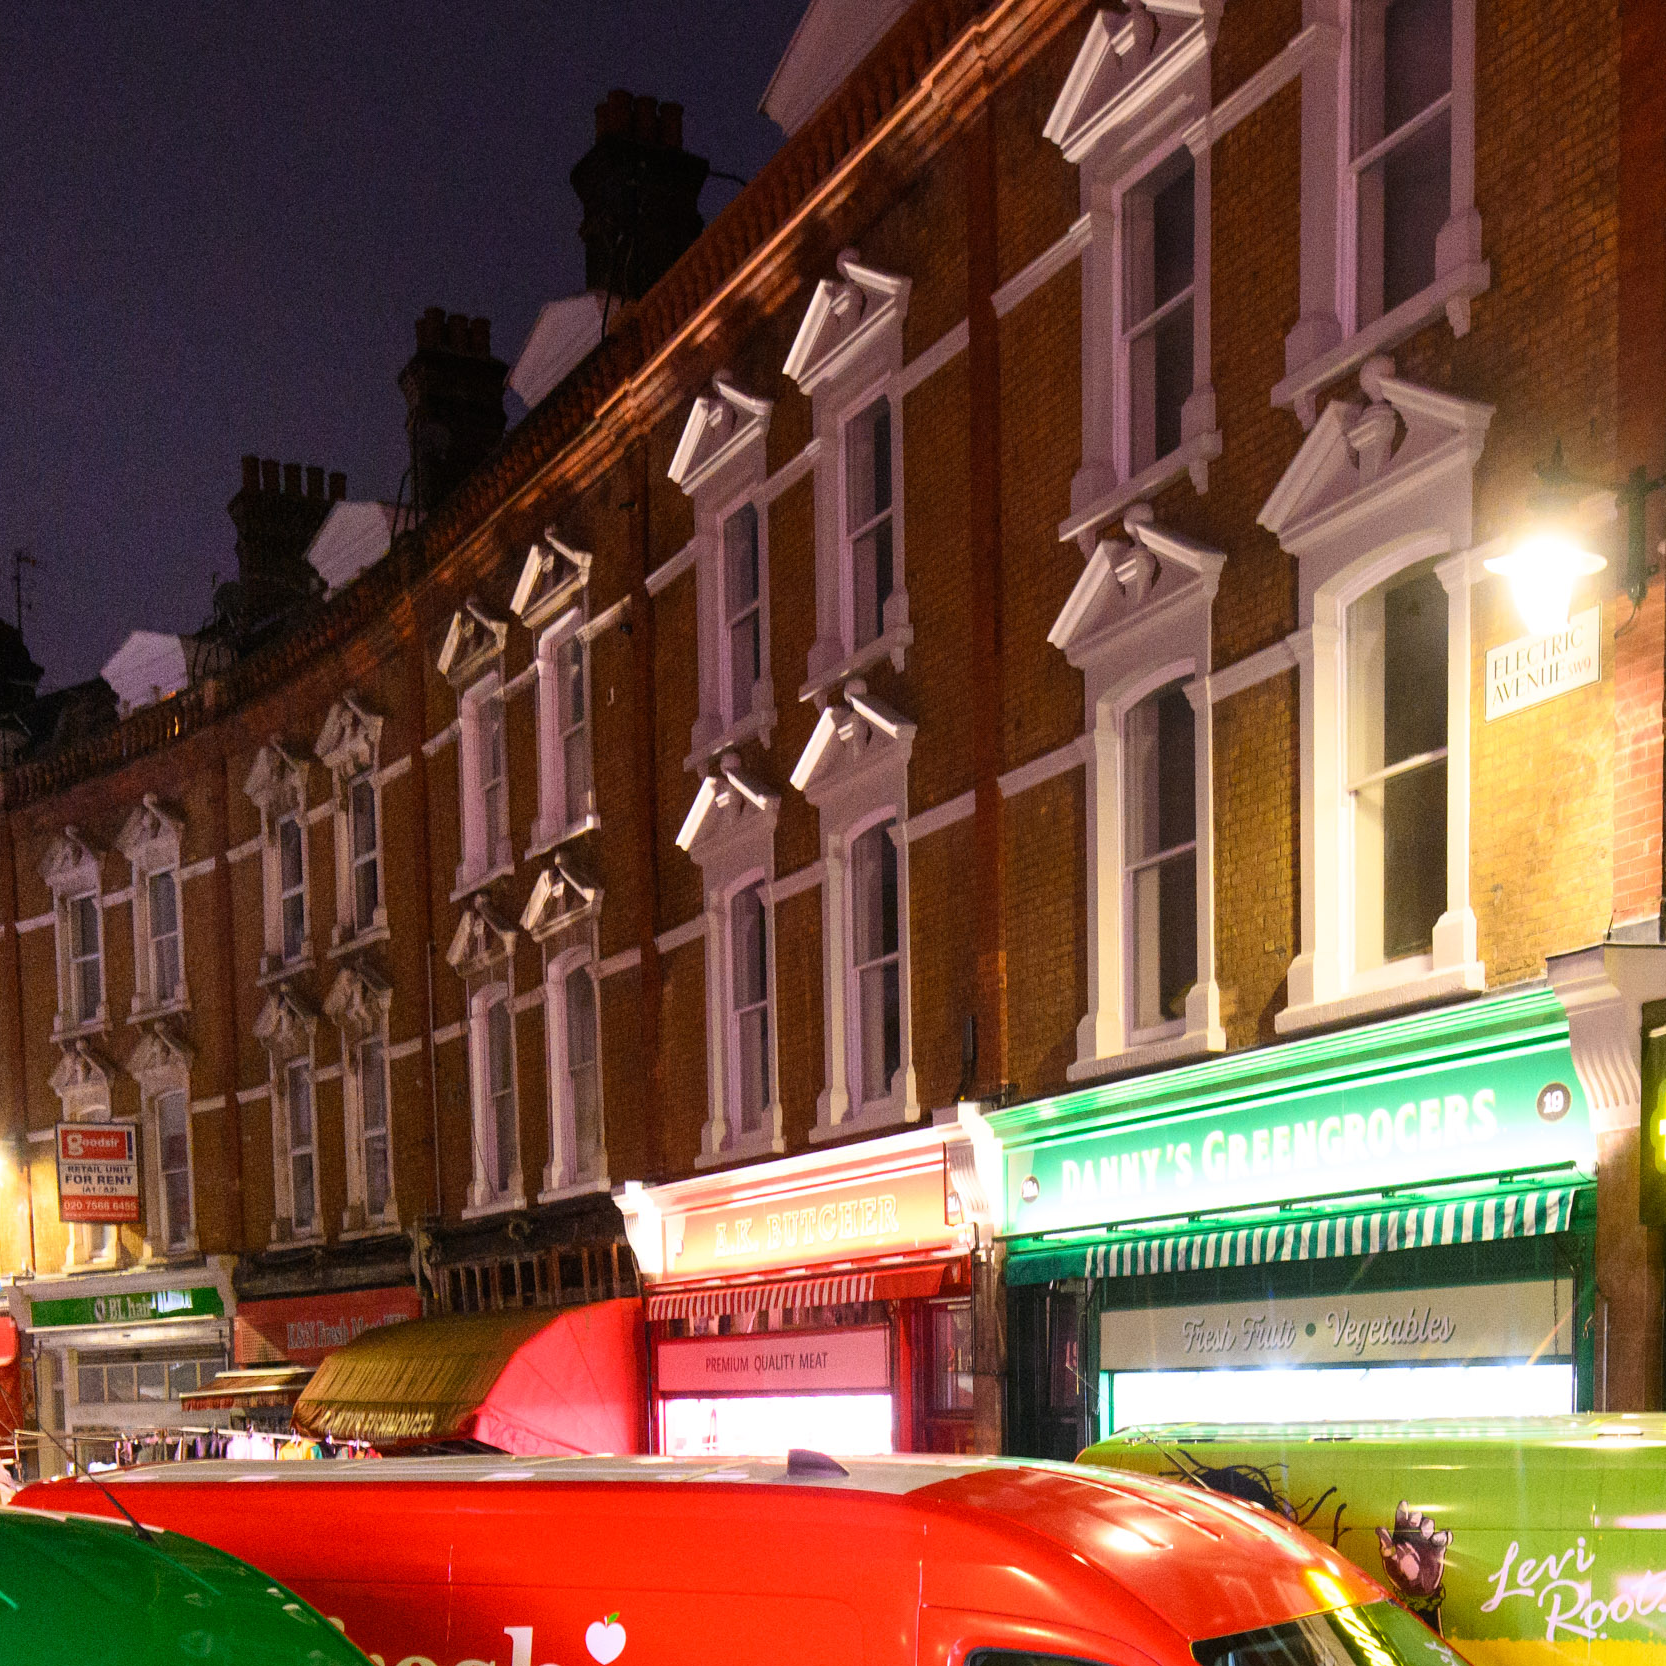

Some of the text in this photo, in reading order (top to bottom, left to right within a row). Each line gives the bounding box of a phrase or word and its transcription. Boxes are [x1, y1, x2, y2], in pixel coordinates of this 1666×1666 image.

[1493, 625, 1584, 680] ELECTRIC
[1492, 662, 1566, 707] AVENUE
[1543, 1089, 1564, 1114] 19
[65, 1174, 133, 1185] FOR RENT
[767, 1194, 900, 1249] BUTCHER
[1181, 1306, 1456, 1357] Fresh Fruit Vegetables
[705, 1351, 829, 1373] PREMIUM QUALITY MEAT
[1479, 1536, 1595, 1614] Levi
